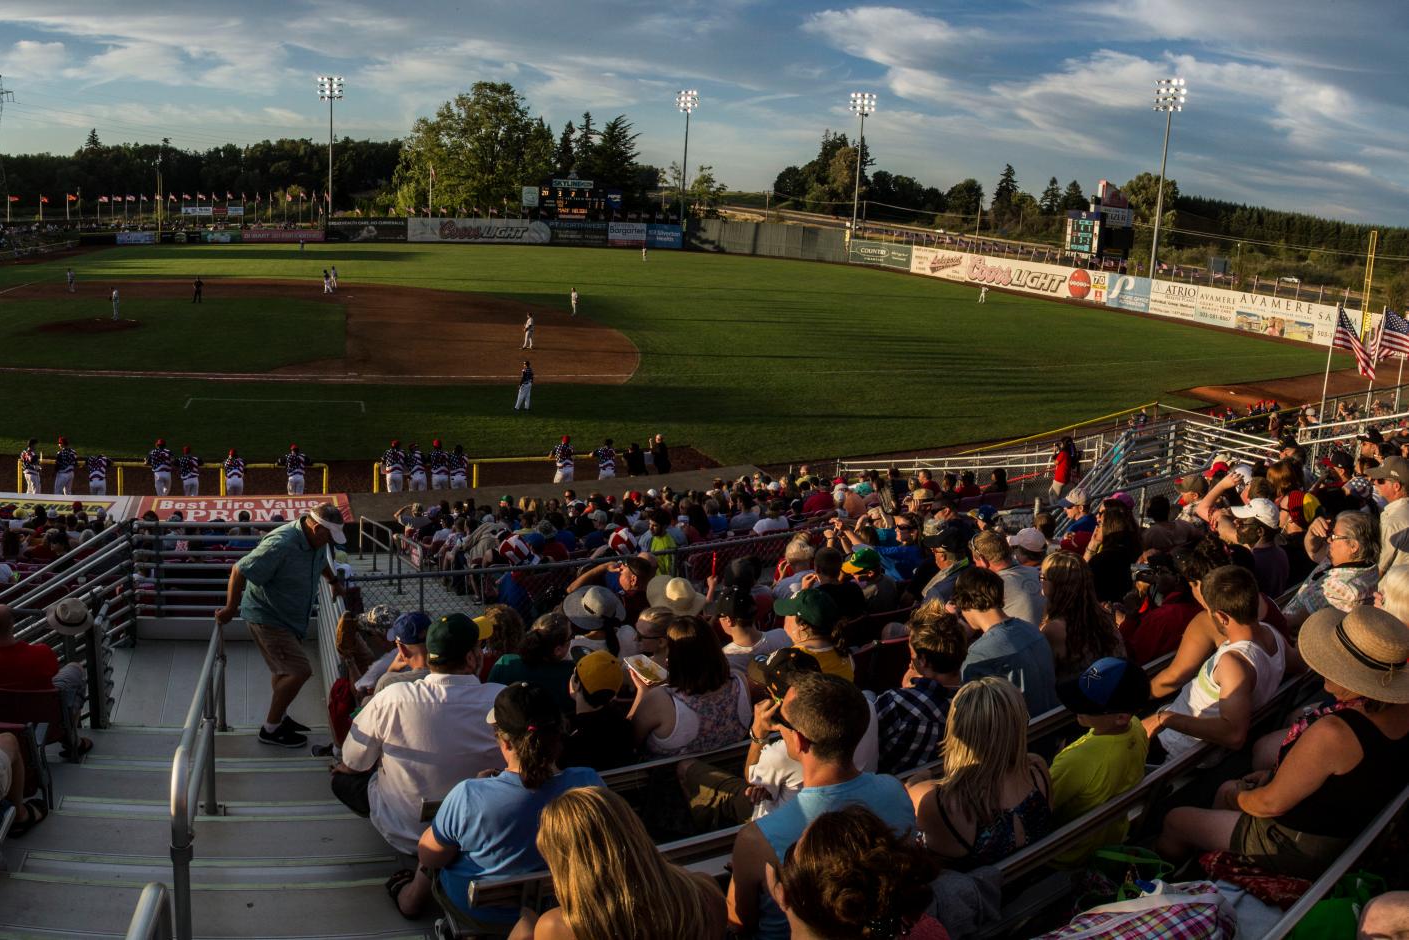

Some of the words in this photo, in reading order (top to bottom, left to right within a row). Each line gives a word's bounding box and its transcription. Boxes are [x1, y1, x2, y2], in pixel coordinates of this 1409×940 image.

[480, 226, 529, 239] LIGHT
[967, 254, 1012, 287] Coors
[1011, 268, 1067, 293] LIGHT
[1165, 285, 1196, 298] ATRIO
[1199, 293, 1236, 305] AVAMERE
[1239, 293, 1314, 316] AVAMERE
[159, 500, 208, 511] Best
[213, 500, 256, 511] Tire
